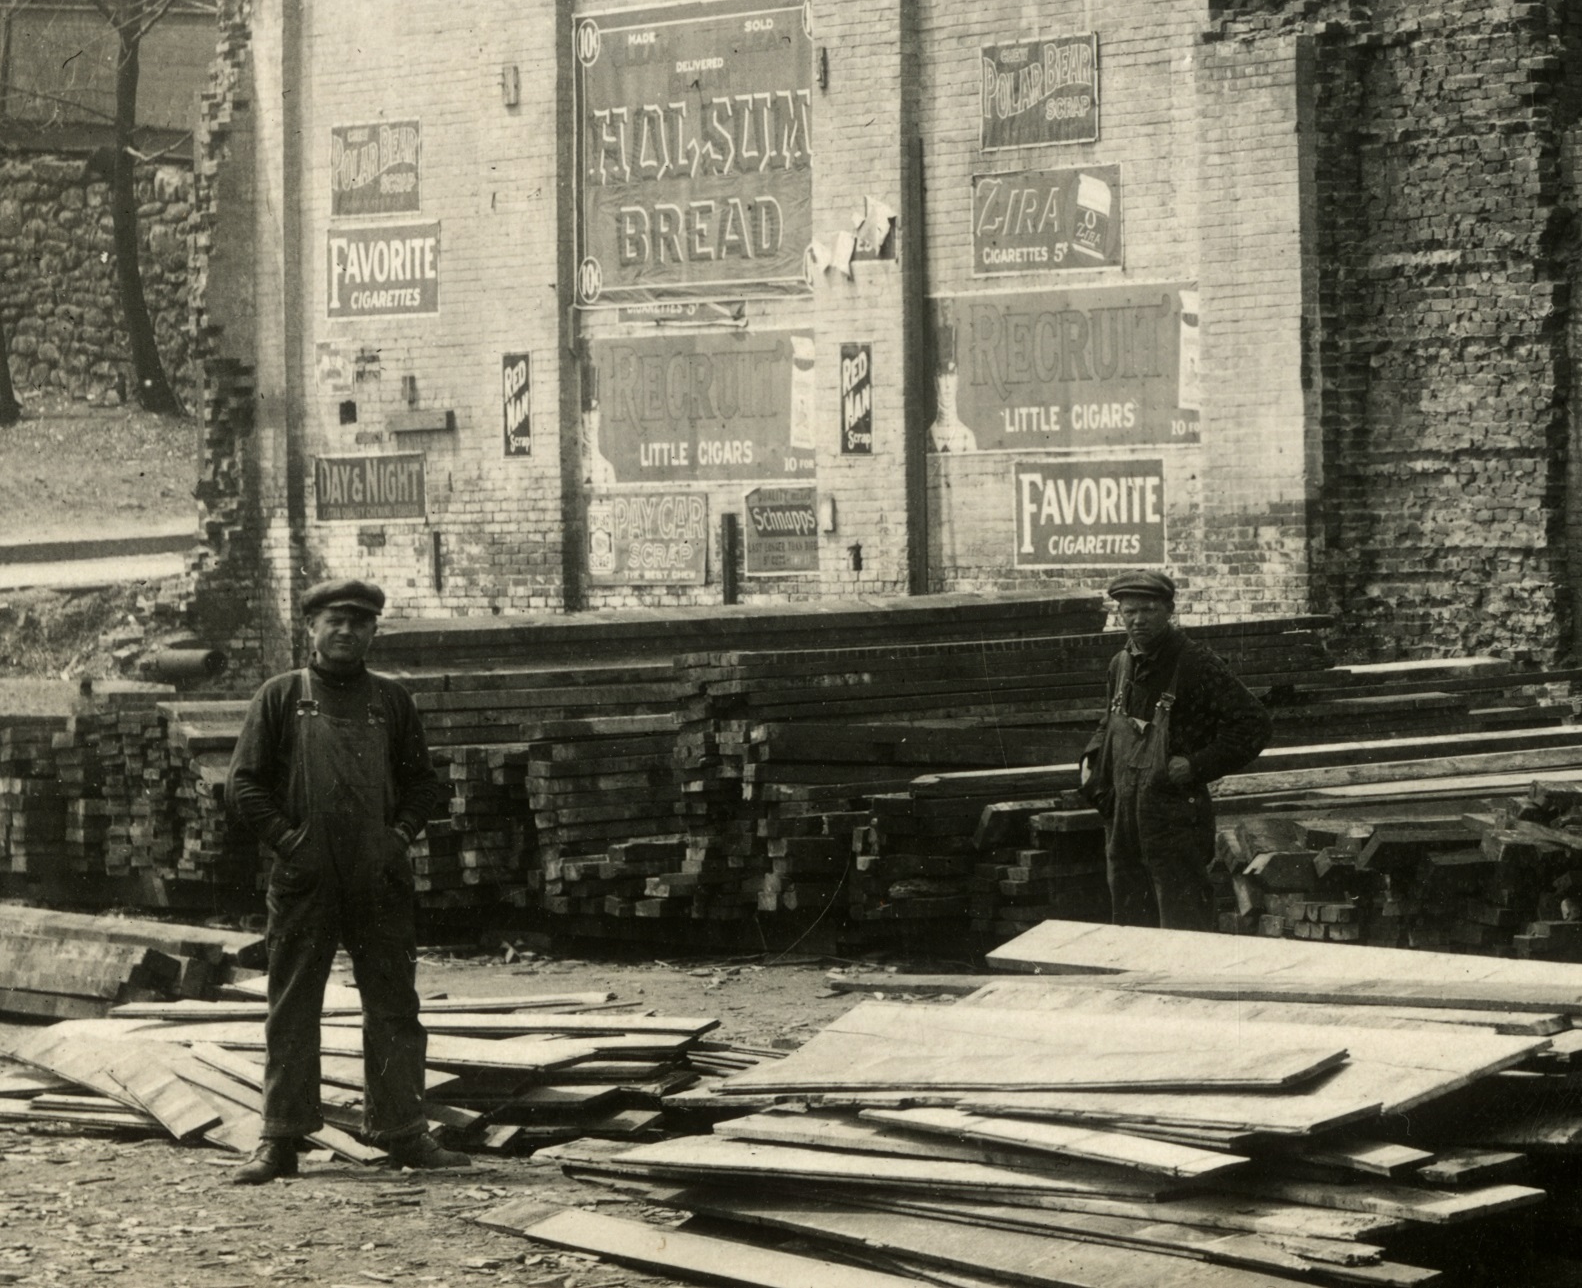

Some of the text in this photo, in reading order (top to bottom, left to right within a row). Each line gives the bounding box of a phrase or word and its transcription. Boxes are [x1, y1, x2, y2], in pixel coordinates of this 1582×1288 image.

[629, 32, 656, 45] MADE
[745, 18, 774, 32] SOLD
[676, 57, 724, 73] DELIVERED
[982, 43, 1092, 119] POLAR BEAR
[1046, 95, 1091, 121] SCRAP
[588, 90, 813, 186] HOLSUM
[331, 125, 418, 191] POLAR BEAR
[381, 173, 416, 194] SCRAP
[976, 178, 1060, 237] ZIRA
[616, 196, 783, 266] BREAD
[982, 246, 1048, 265] CIGARETTES
[329, 237, 437, 309] FAVORITE
[351, 288, 421, 310] CIGARETTES
[969, 293, 1171, 402] RECRUIT
[505, 360, 527, 403] RED
[610, 340, 786, 437] RECRUIT
[843, 351, 868, 397] RED
[1004, 401, 1136, 433] LITTLE CIGARS
[1171, 419, 1186, 436] 10
[640, 439, 754, 467] LITTLE CIGARS
[784, 456, 798, 472] 10
[320, 459, 352, 504] DAY
[365, 457, 421, 504] NIGHT
[614, 496, 706, 540] PAY CAR
[752, 507, 816, 536] Schnapps
[1018, 473, 1161, 554] FAVORITE
[628, 542, 694, 569] SCRAP
[1048, 534, 1141, 555] CIGARETTES
